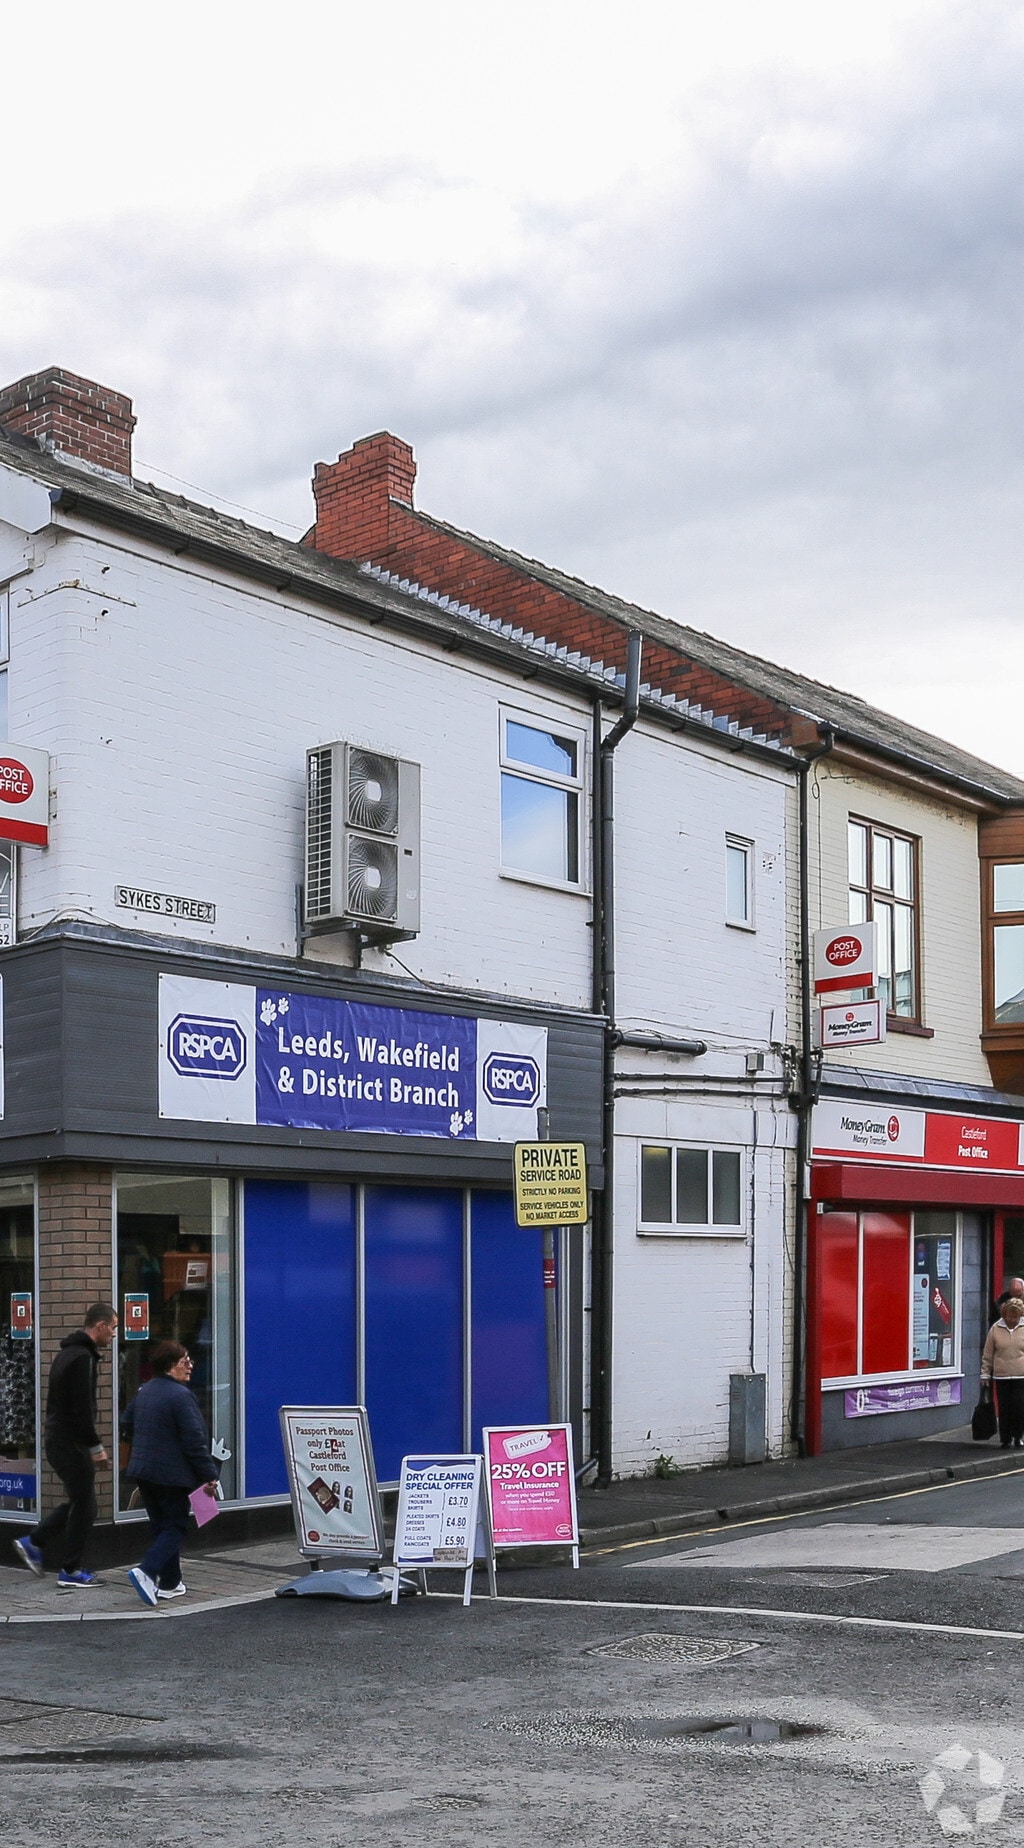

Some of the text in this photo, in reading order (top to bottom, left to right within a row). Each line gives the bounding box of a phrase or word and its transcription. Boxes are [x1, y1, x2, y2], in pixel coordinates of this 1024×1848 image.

[119, 889, 213, 919] SYKES STREET
[834, 940, 855, 951] POST
[829, 949, 858, 961] OFFICE
[828, 1020, 873, 1031] MoneyGram
[178, 1030, 238, 1063] RSPCA
[278, 1027, 460, 1073] Leeds, Wakefield
[490, 1067, 533, 1093] RSPCA
[277, 1065, 459, 1108] & District Branch
[840, 1116, 886, 1135] MoneyGram
[853, 1134, 869, 1147] Money
[957, 1144, 988, 1159] Post Office
[521, 1148, 579, 1168] PRIVATE
[520, 1169, 582, 1182] SERVICE ROAD
[522, 1186, 581, 1197] STRICTLY NO PARKING
[520, 1200, 584, 1211] SERVICE VEHICLES ONLY
[525, 1210, 580, 1220] NO MARKET ACCESS
[295, 1426, 354, 1437] Passport Photos
[307, 1440, 323, 1449] only
[509, 1438, 538, 1452] TRAVEL
[308, 1450, 347, 1460] Castleford
[310, 1462, 351, 1473] Post Office
[491, 1461, 566, 1480] 25% OFF
[406, 1472, 475, 1481] DRY CLEANING
[405, 1481, 473, 1491] SPECIAL OFFER
[500, 1481, 560, 1490] Travel Insurance
[448, 1496, 469, 1506] £3.70
[446, 1517, 467, 1527] £4.80
[445, 1535, 465, 1546] £5.90
